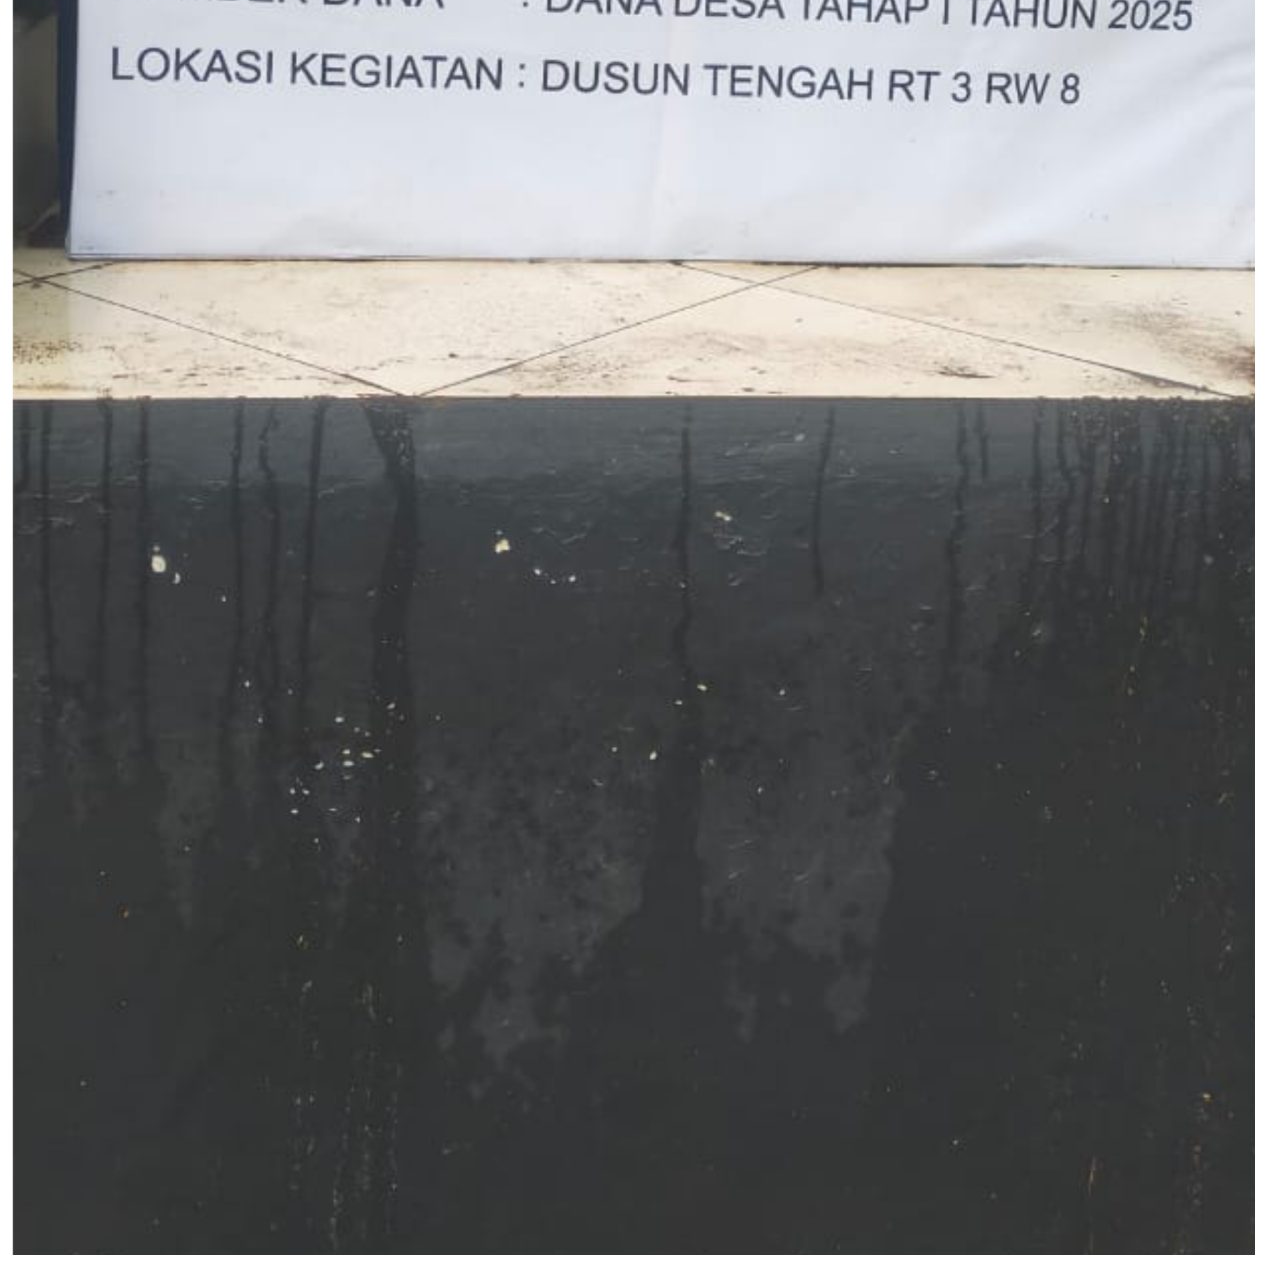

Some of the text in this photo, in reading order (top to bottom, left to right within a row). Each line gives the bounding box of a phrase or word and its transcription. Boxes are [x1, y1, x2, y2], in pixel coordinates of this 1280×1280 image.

[111, 46, 274, 84] LOKASI
[290, 51, 503, 90] KEGIATAN
[542, 59, 690, 96] DUSUN
[703, 64, 874, 101] TENGAH
[888, 69, 941, 102] RT
[951, 71, 972, 103] 3
[985, 72, 1051, 105] RW
[1060, 72, 1080, 105] 8
